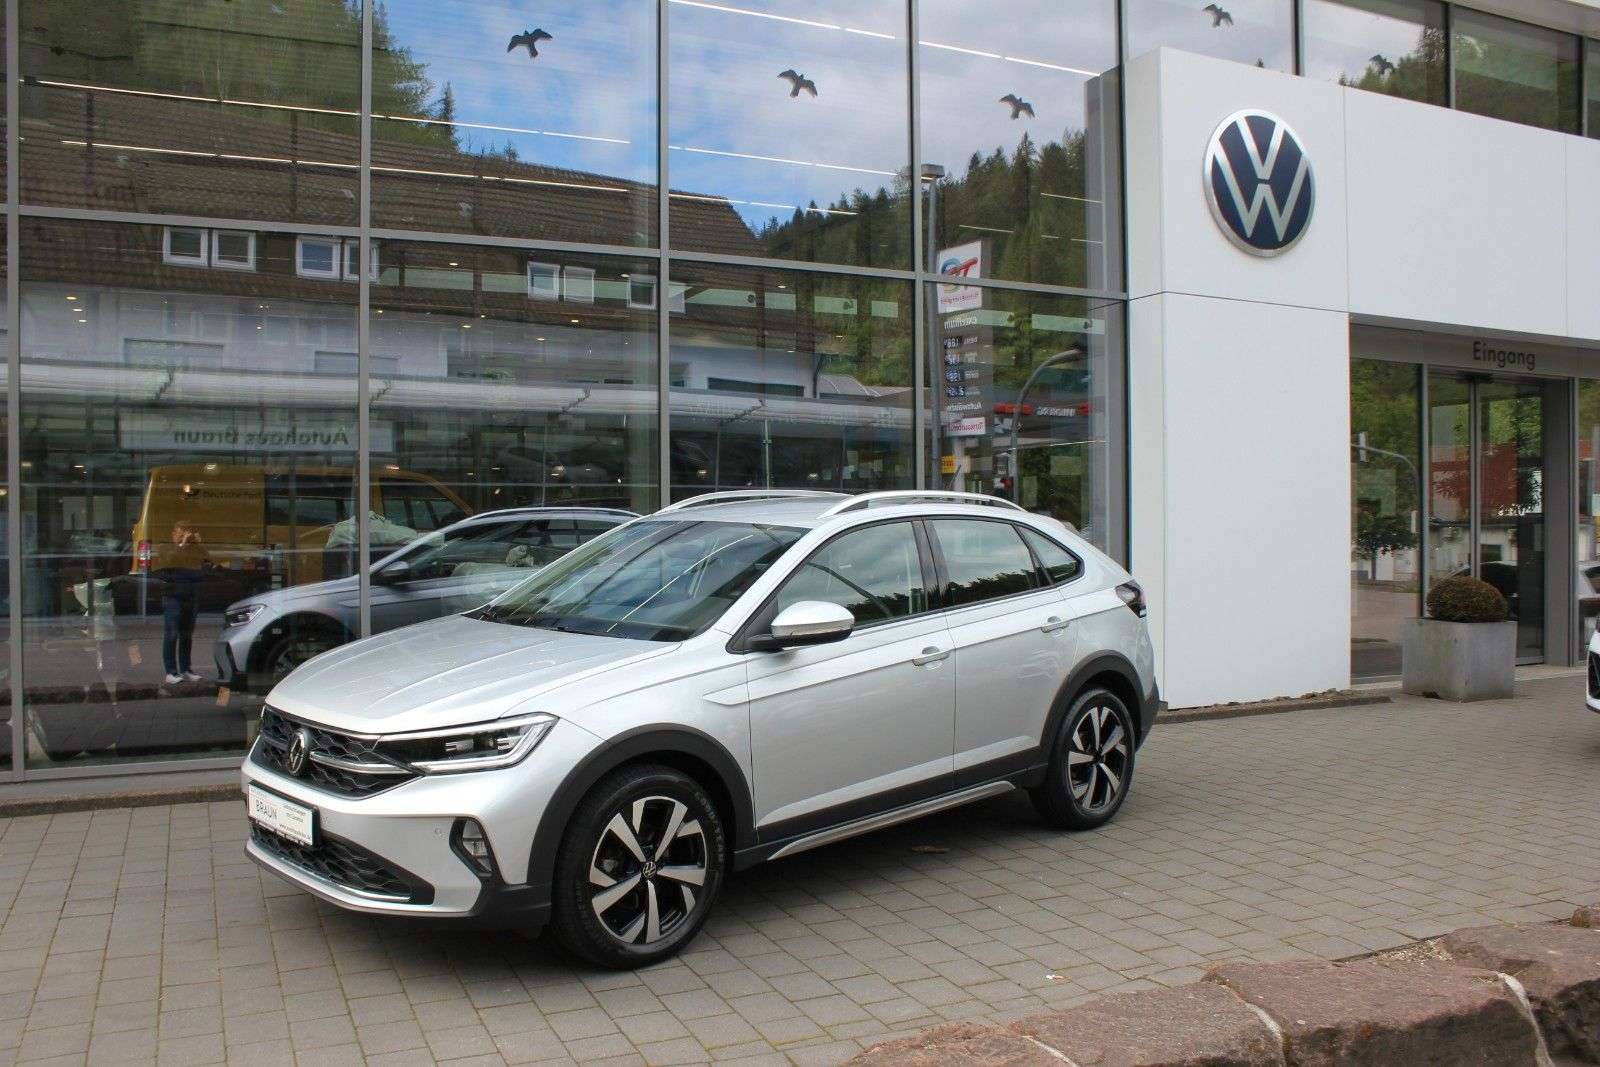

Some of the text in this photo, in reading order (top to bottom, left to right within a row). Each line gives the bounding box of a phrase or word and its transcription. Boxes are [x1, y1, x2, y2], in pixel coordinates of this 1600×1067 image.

[1207, 111, 1313, 250] VW
[1473, 340, 1536, 371] Eingang
[255, 799, 278, 820] BRAUN
